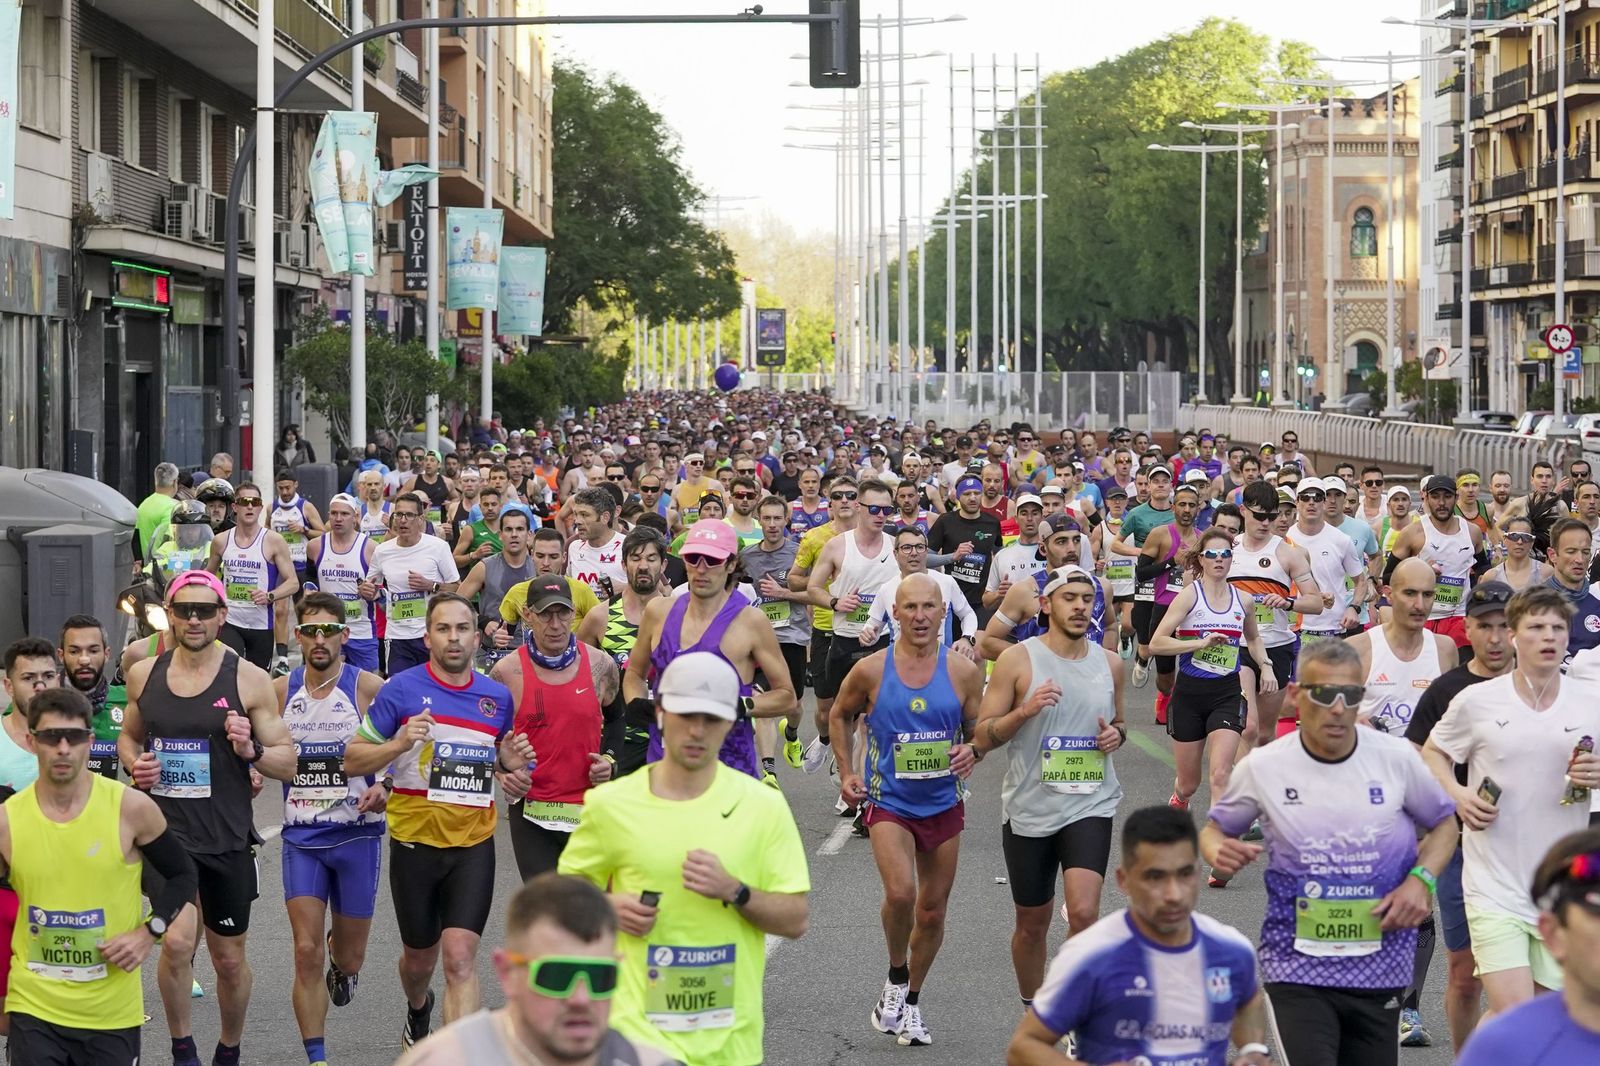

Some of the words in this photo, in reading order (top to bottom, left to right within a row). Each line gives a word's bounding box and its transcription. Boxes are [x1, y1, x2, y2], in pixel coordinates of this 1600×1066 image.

[410, 183, 425, 269] ENTOFT
[1563, 351, 1576, 367] P
[224, 560, 261, 569] BLACKBURN
[322, 570, 359, 578] BLACKBURN
[1202, 652, 1228, 665] BECKY
[317, 722, 352, 731] ATLETISMO
[914, 731, 946, 740] ZURICH
[165, 742, 200, 750] ZURICH
[305, 745, 339, 753] ZURICH
[456, 748, 489, 758] ZURICH
[916, 748, 933, 756] 2603
[167, 760, 184, 768] 9557
[308, 762, 326, 770] 3995
[907, 759, 940, 770] ETHAN
[455, 765, 474, 775] 4984
[1043, 770, 1067, 780] PAPÁ
[1070, 772, 1081, 780] DE
[1084, 772, 1104, 780] ARIA
[161, 772, 195, 783] SEBAS
[294, 774, 330, 785] OSCAR
[333, 774, 344, 785] G.
[440, 776, 483, 791] MORÁN
[1326, 886, 1374, 896] ZURICH
[1328, 909, 1352, 919] 3224
[51, 915, 95, 925] ZURICH
[1315, 923, 1363, 938] CARRI
[41, 947, 92, 964] VICTOR
[678, 949, 726, 963] ZURICH
[679, 977, 706, 987] 3056
[665, 990, 717, 1011] WÜIYE
